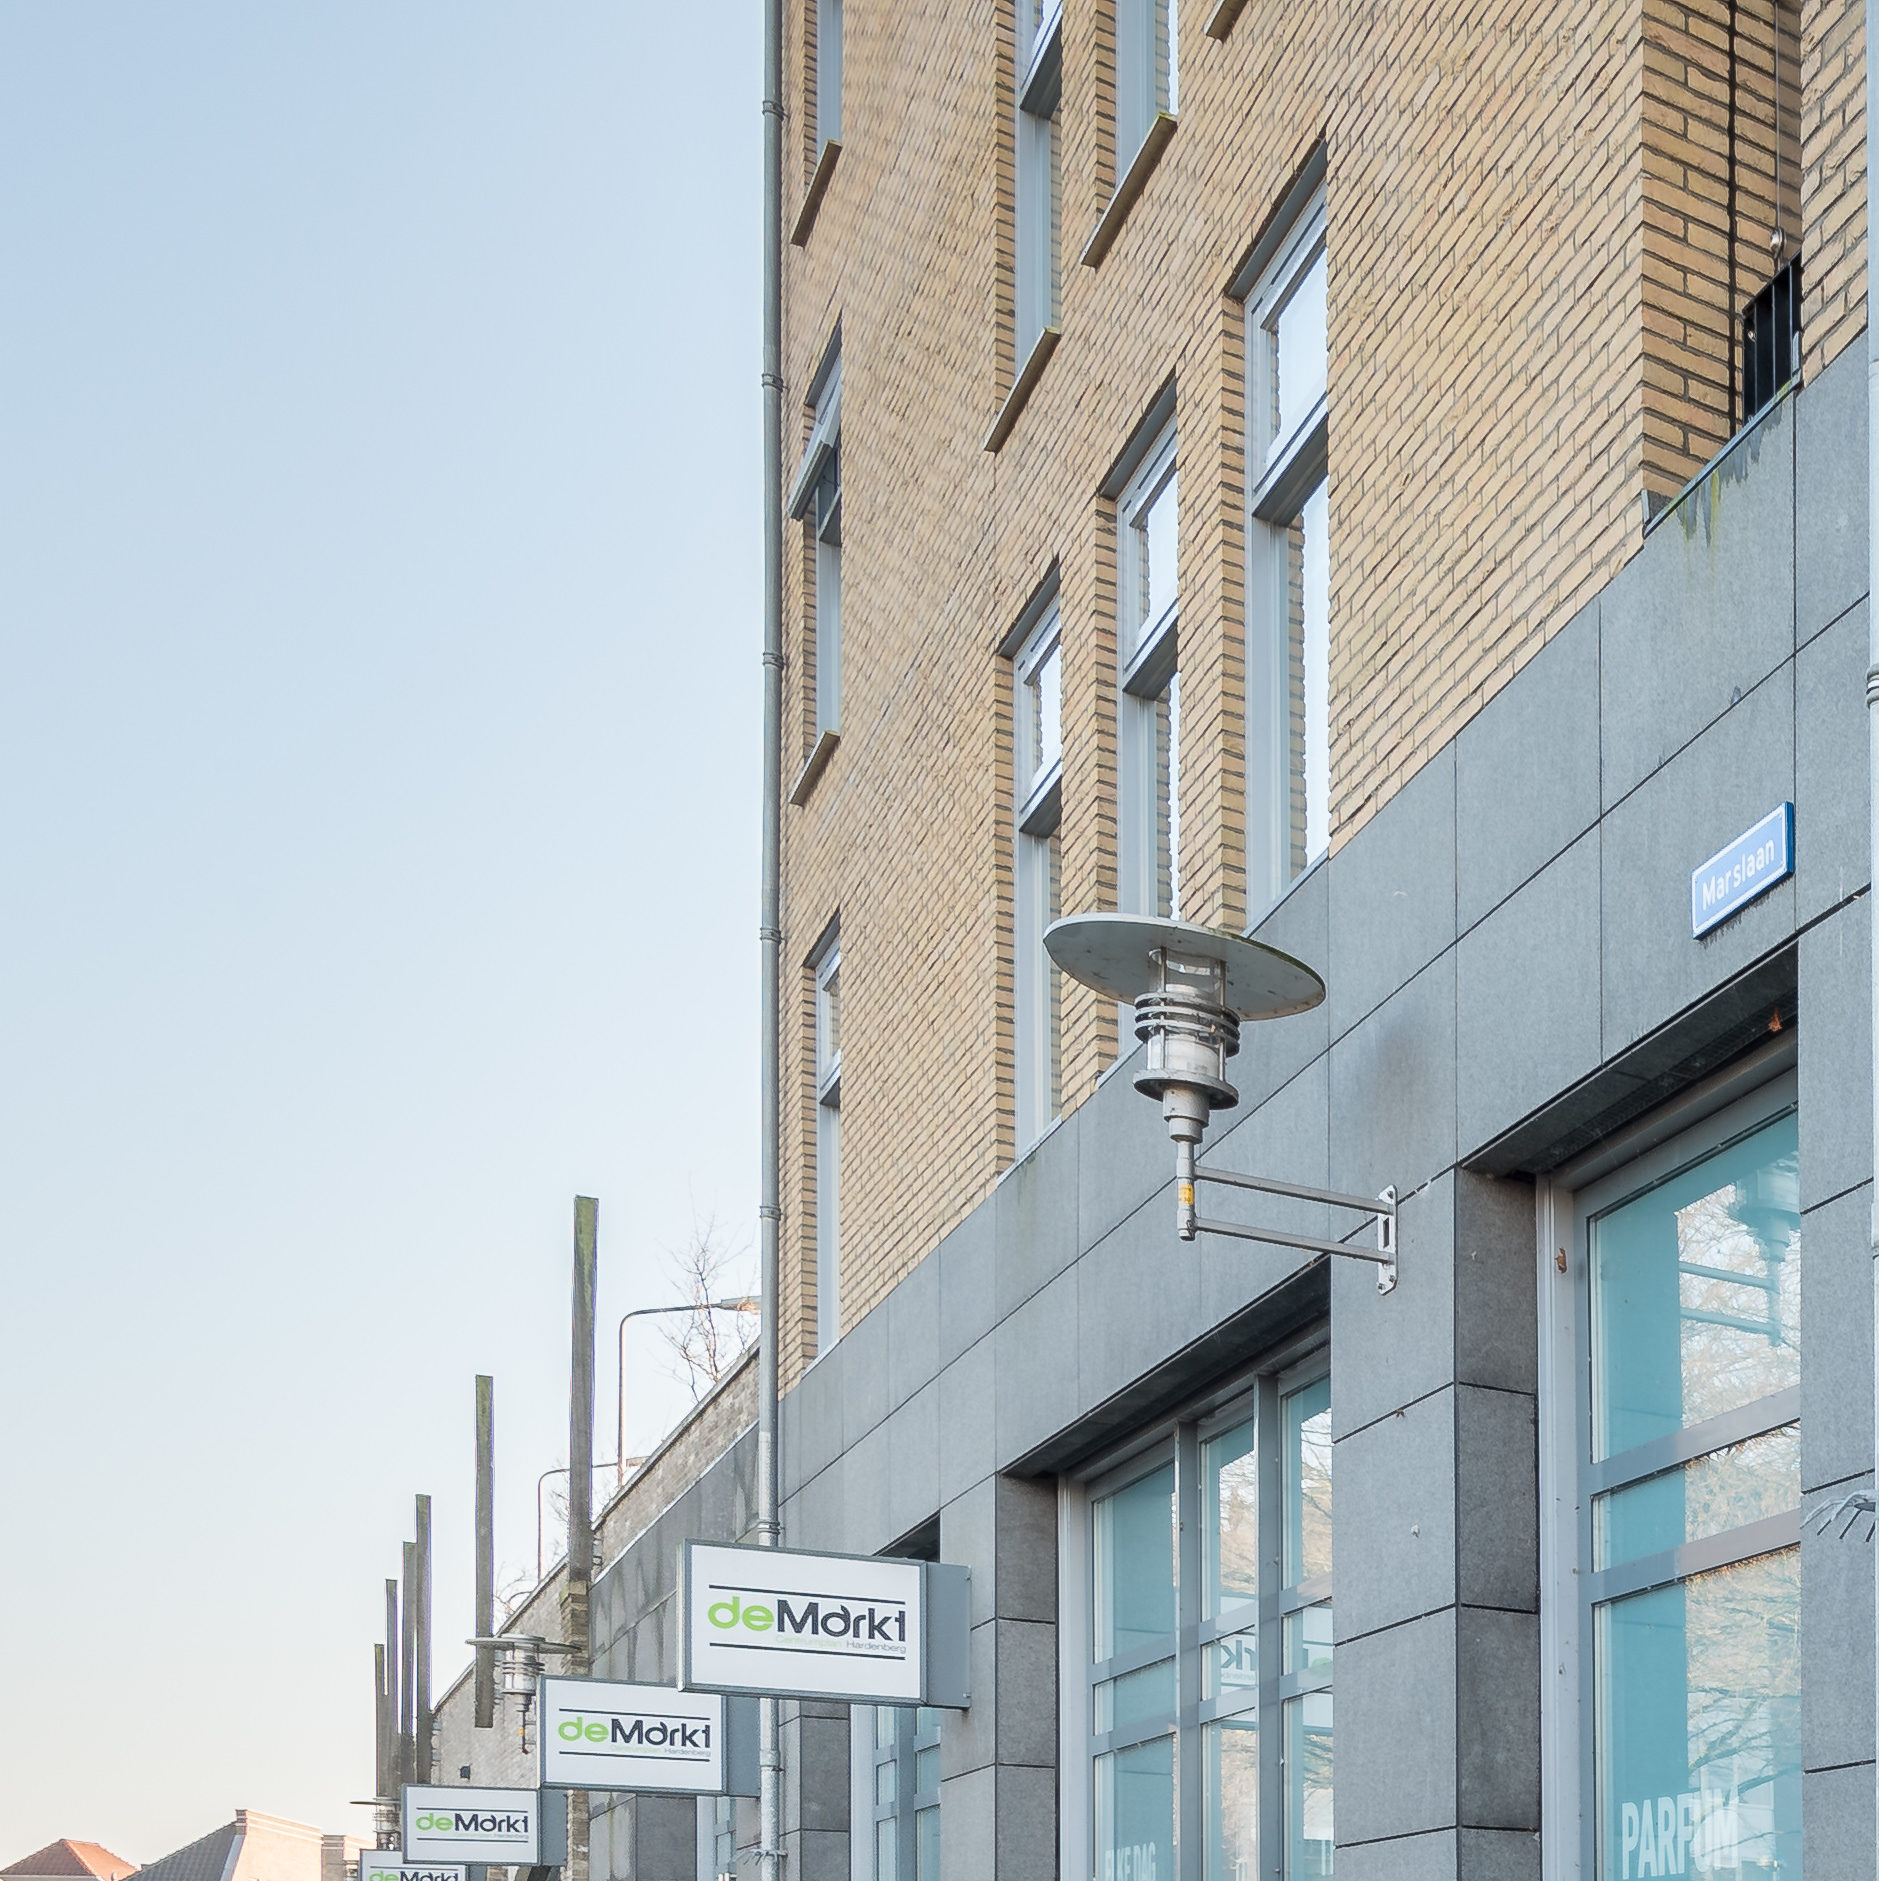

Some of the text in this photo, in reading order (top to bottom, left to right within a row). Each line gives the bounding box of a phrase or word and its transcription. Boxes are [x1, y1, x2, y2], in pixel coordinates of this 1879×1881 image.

[1702, 839, 1775, 911] Marslaan
[846, 1640, 907, 1654] Hardenberg
[1622, 1789, 1740, 1880] PARFUM
